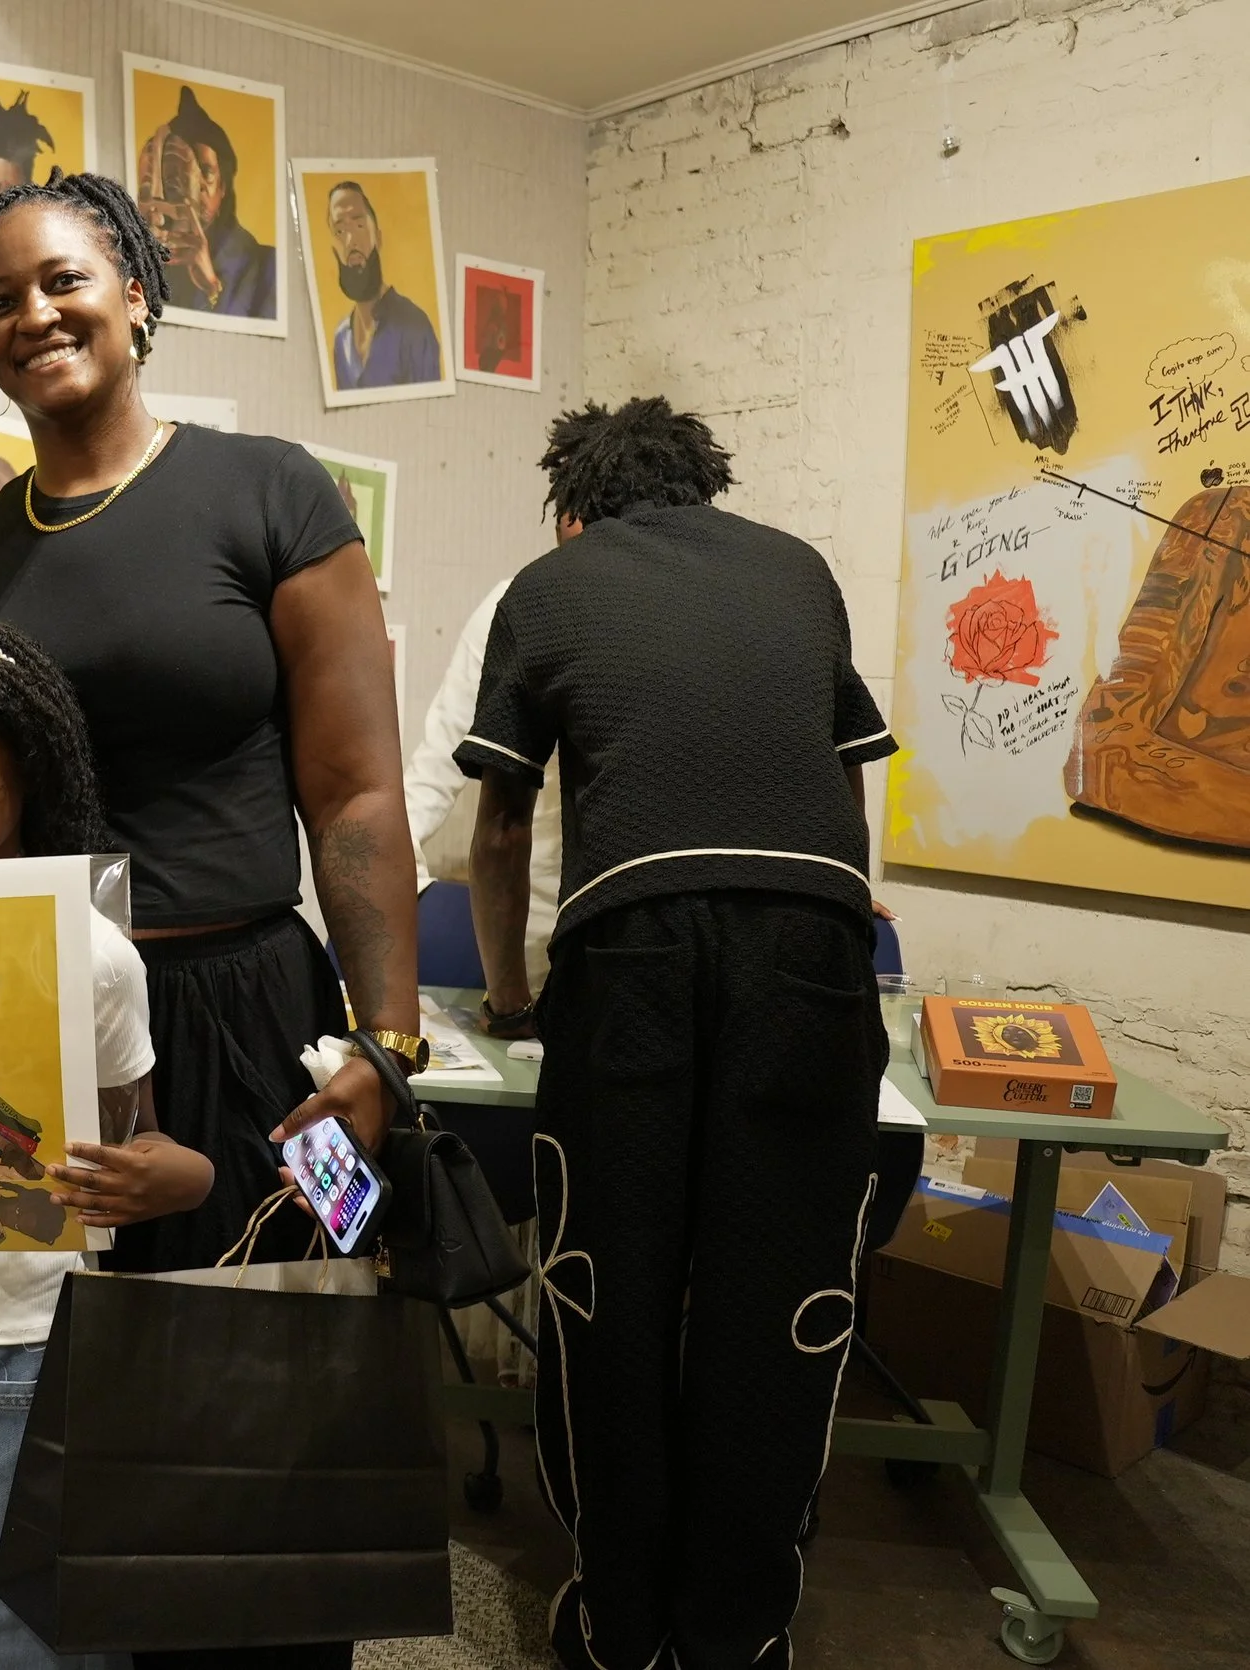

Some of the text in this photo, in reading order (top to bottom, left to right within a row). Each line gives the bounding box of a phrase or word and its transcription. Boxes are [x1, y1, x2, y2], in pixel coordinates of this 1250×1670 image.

[1161, 362, 1185, 377] Cogito
[1187, 354, 1204, 365] ergo
[958, 1000, 1053, 1011] GOLDEN HOUR
[952, 1059, 981, 1067] 500
[1007, 1079, 1047, 1095] CHEERS
[1003, 1090, 1048, 1102] CULTURE
[0, 1103, 19, 1119] SULA
[1101, 1220, 1126, 1231] prime
